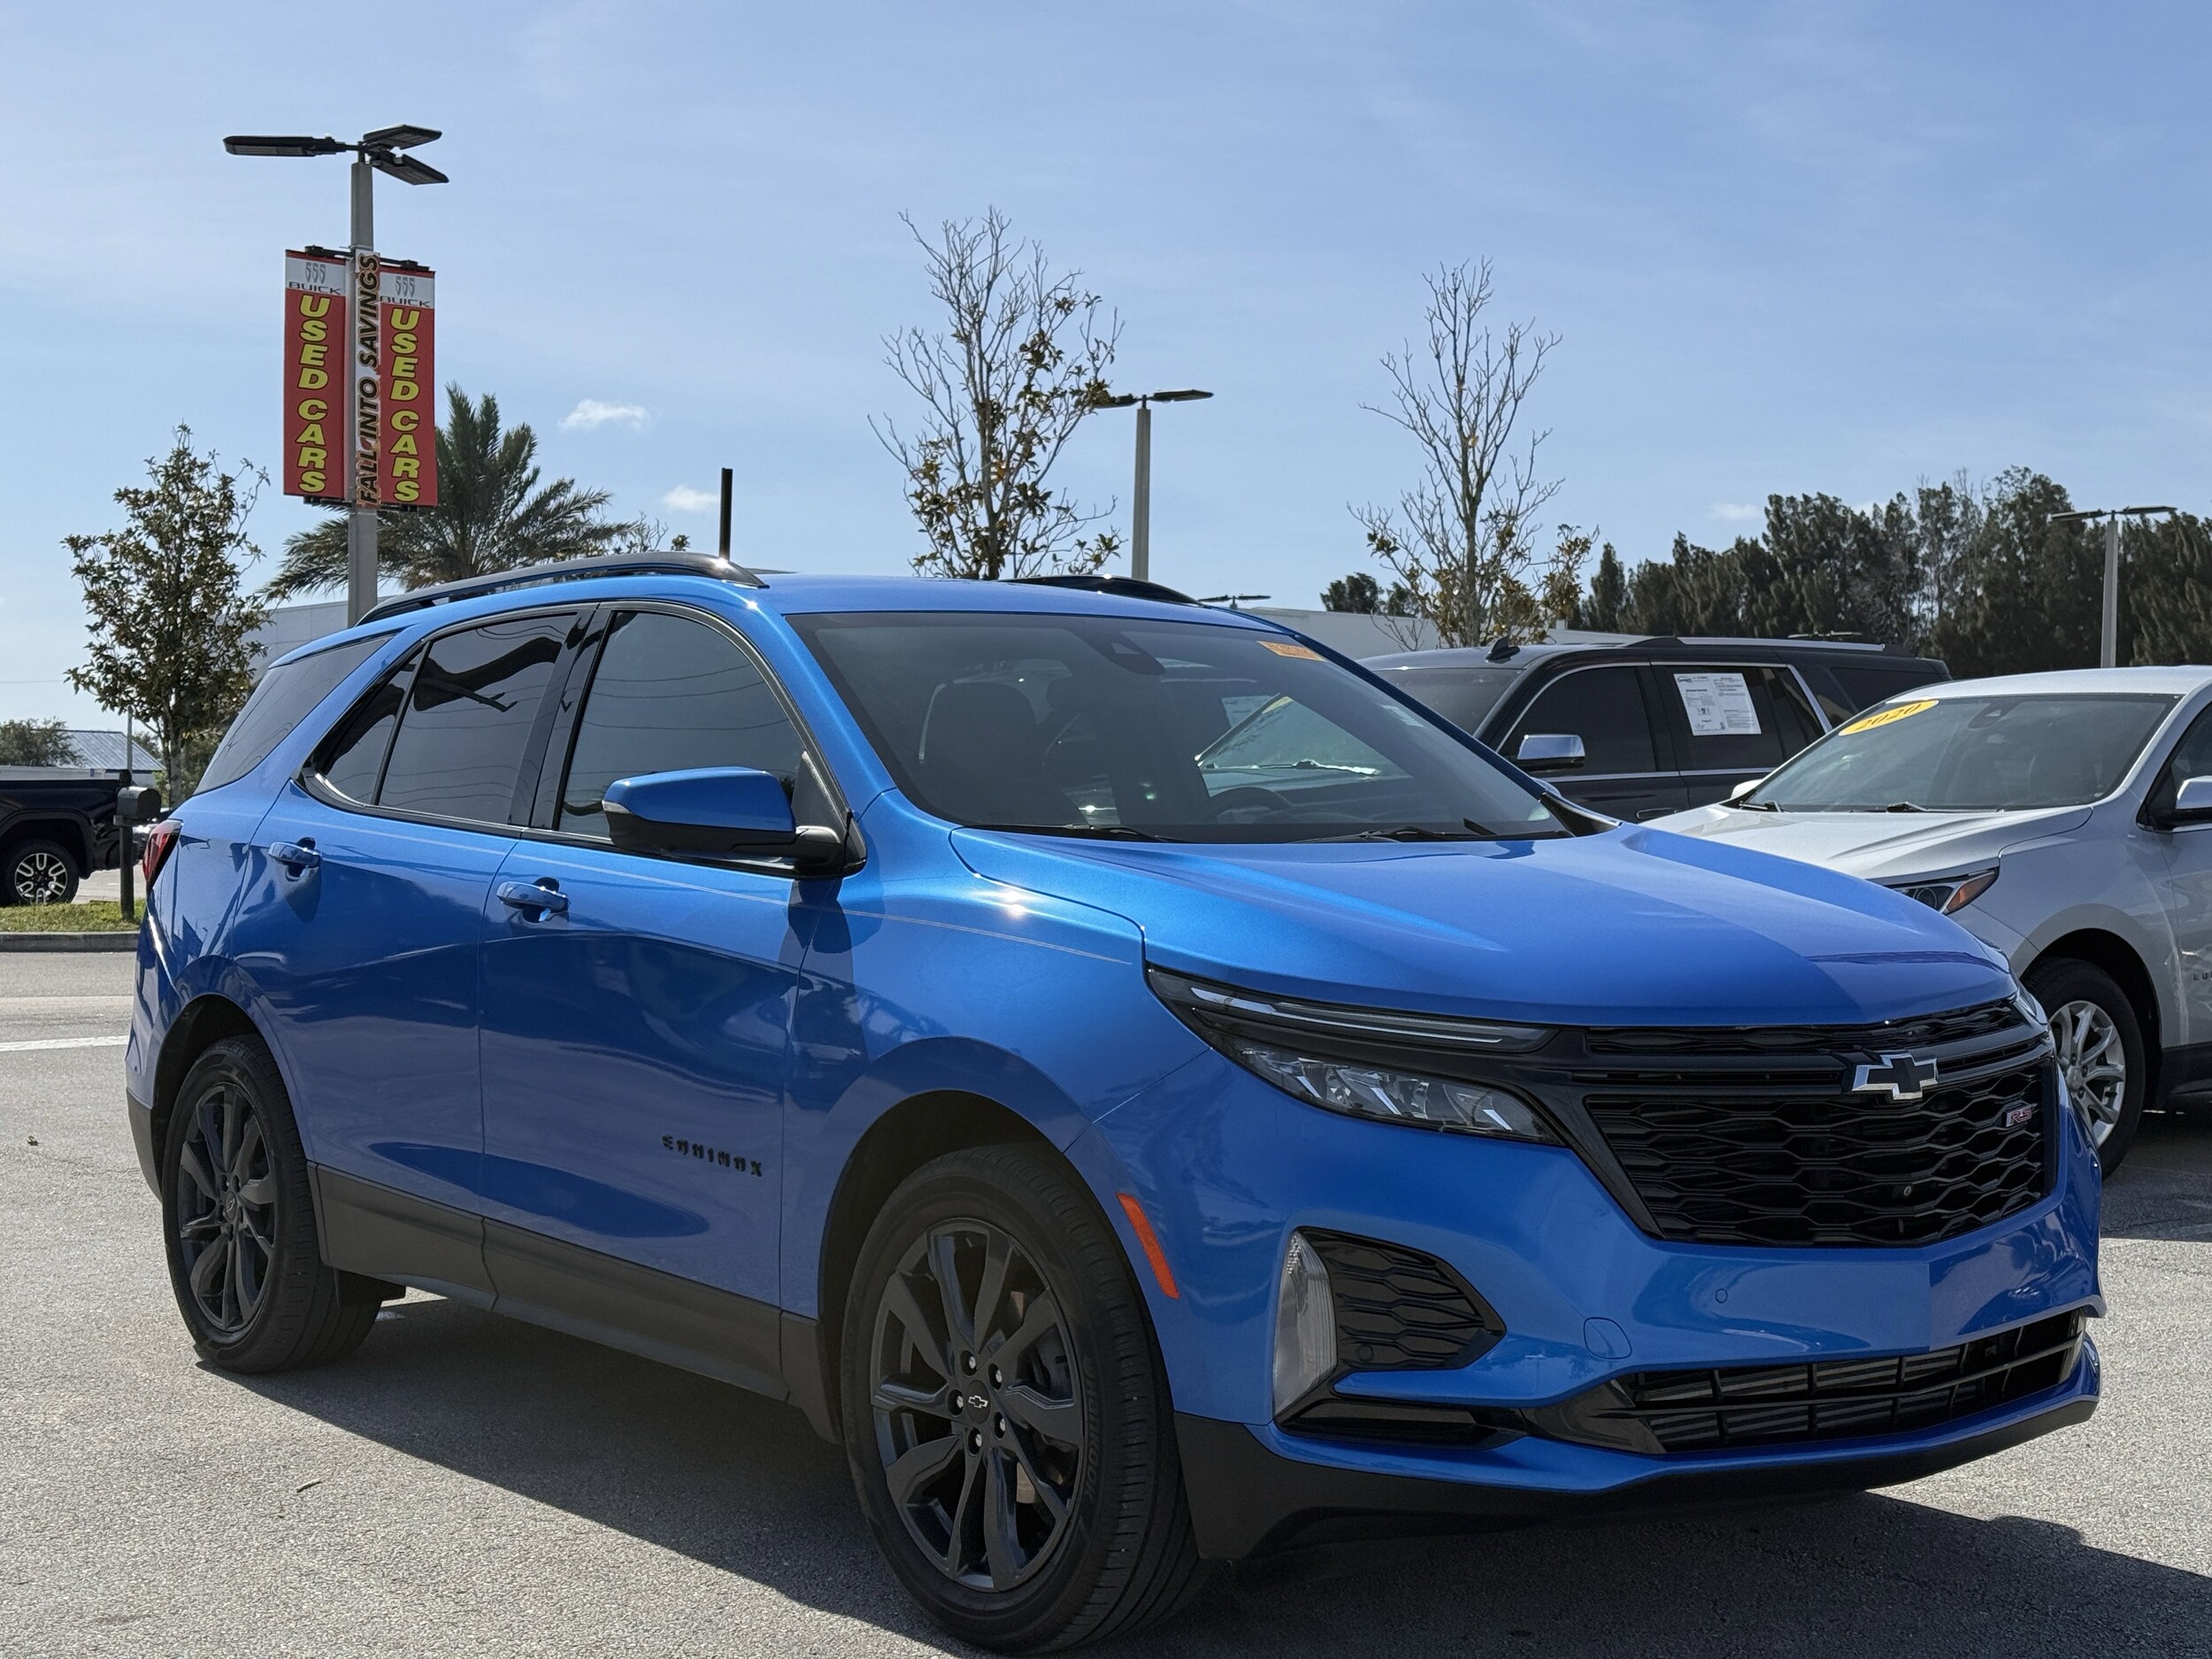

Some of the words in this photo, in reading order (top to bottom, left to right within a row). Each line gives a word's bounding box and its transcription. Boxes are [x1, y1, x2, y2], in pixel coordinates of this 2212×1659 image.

[288, 280, 342, 296] BUICK
[358, 253, 380, 369] SAVINGS
[380, 296, 430, 308] BUICK
[298, 295, 331, 390] USED
[389, 308, 420, 402] USED
[358, 378, 379, 441] INTO
[295, 397, 328, 494] CARS
[389, 409, 420, 504] CARS
[359, 450, 378, 504] FALL
[1855, 703, 1922, 731] 2020
[2007, 1106, 2032, 1127] RS
[662, 1134, 763, 1178] EQUINOX
